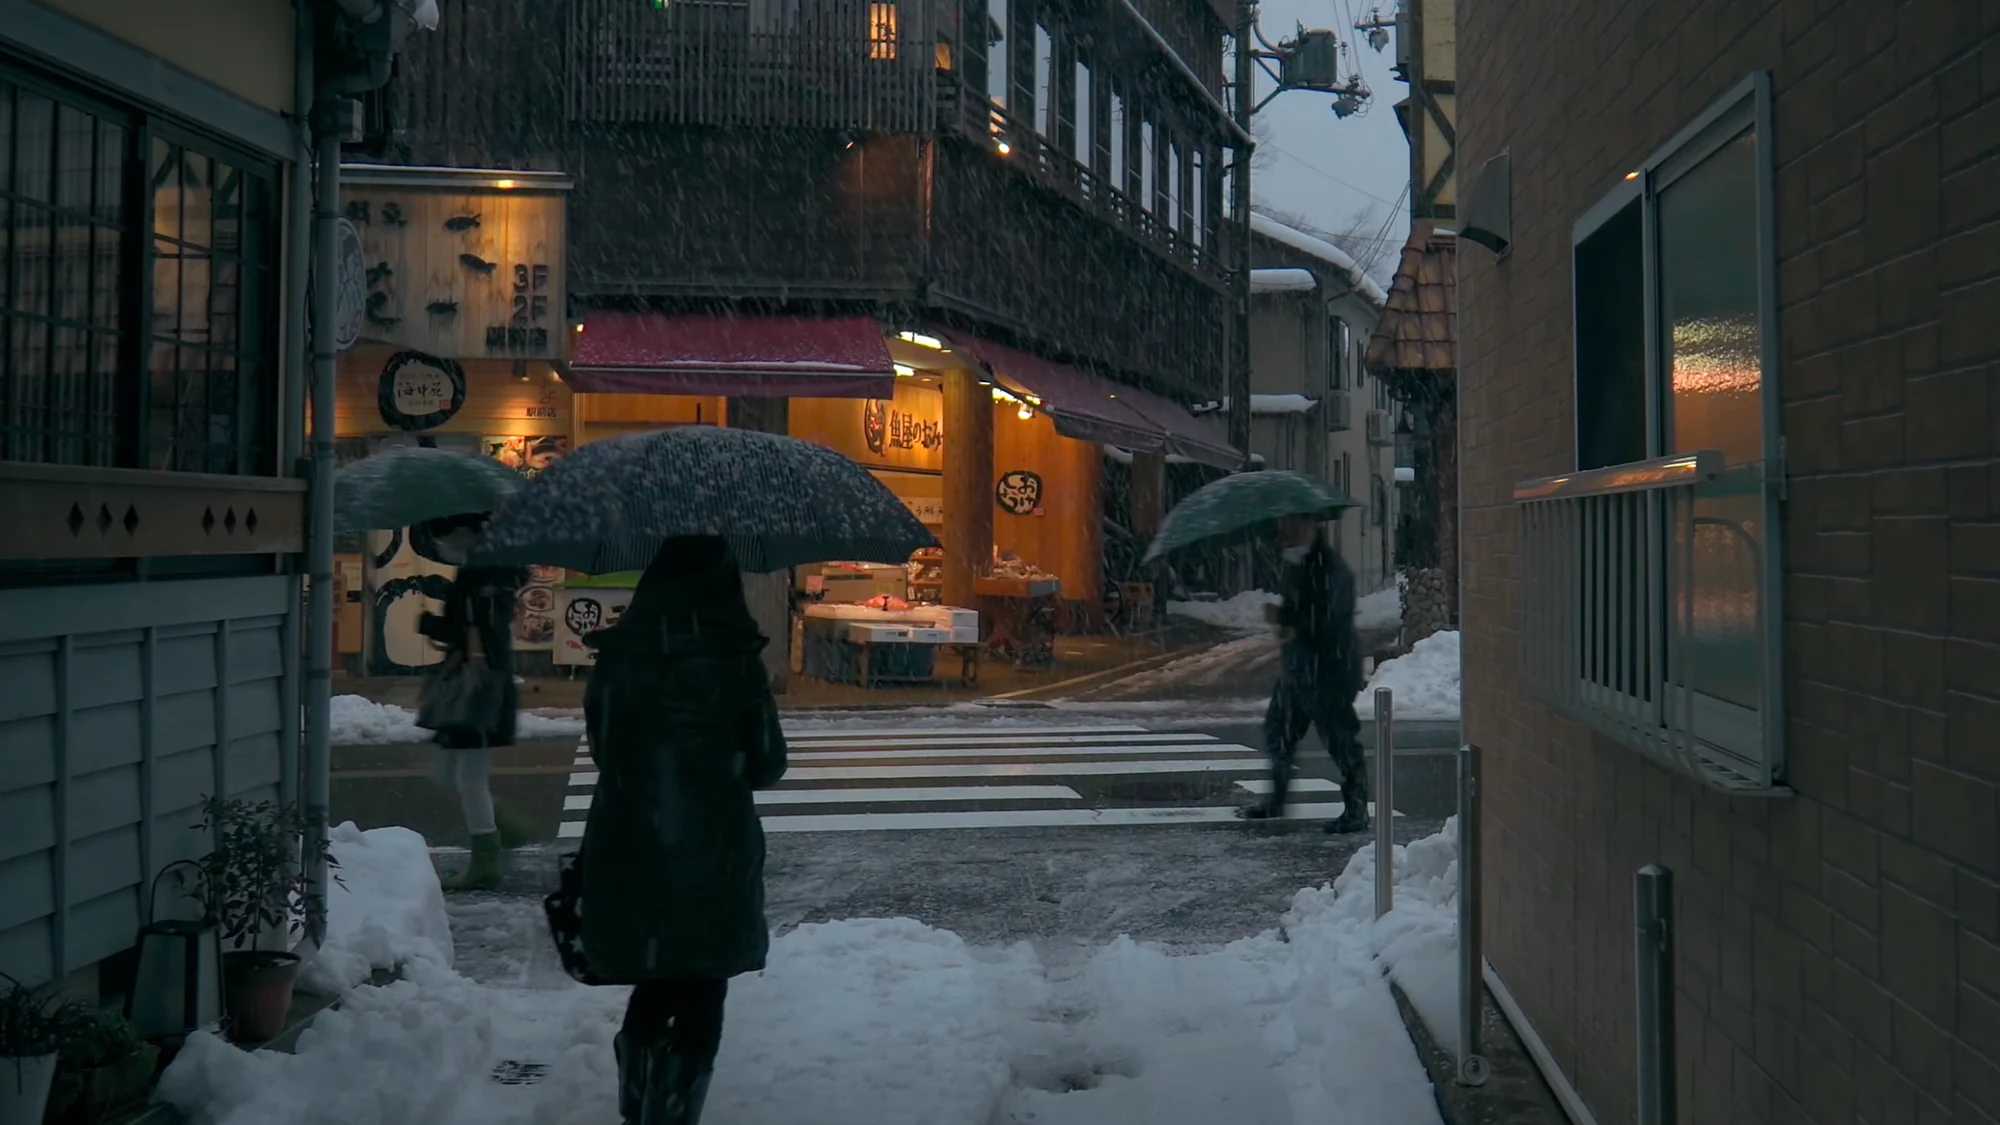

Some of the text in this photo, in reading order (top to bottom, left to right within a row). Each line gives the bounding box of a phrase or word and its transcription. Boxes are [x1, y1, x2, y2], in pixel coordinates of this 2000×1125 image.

[514, 263, 549, 292] 3F
[513, 295, 548, 323] 2F
[888, 409, 944, 452] 魚屋のおみ
